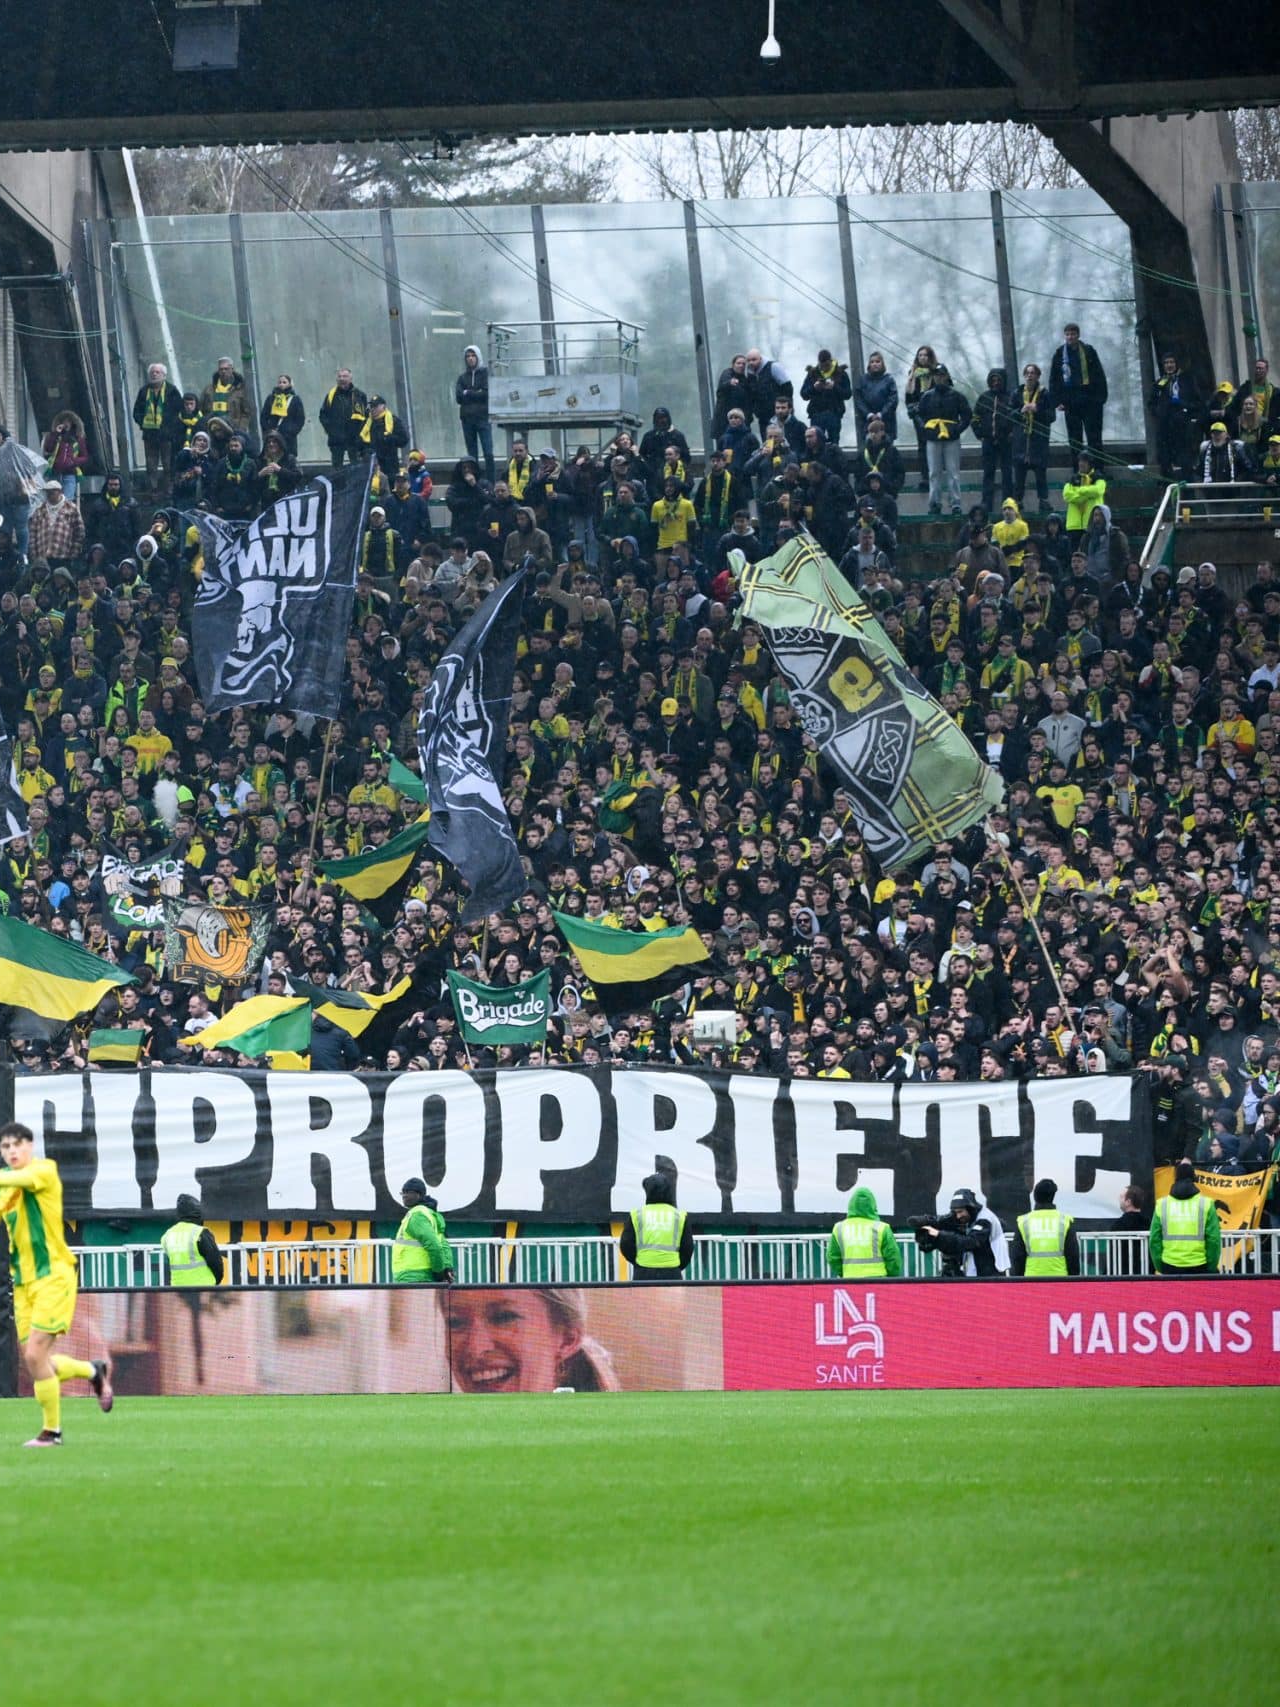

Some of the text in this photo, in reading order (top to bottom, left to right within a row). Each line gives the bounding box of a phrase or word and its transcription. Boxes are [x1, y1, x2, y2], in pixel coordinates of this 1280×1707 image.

[114, 898, 166, 924] LOIR
[456, 988, 546, 1025] Brigade
[1049, 1310, 1252, 1354] MAISONS
[815, 1361, 884, 1383] SANTÉ
